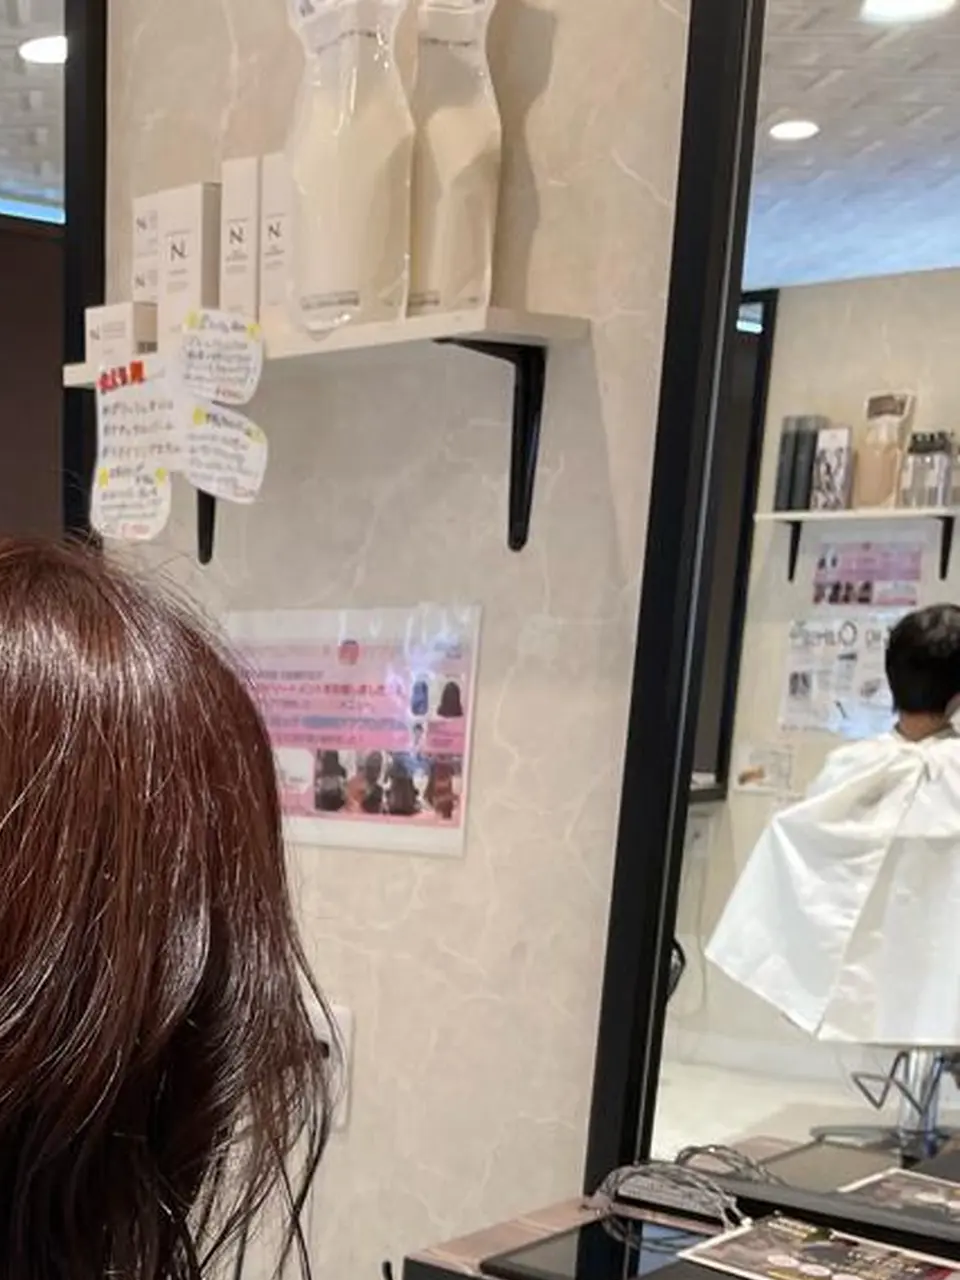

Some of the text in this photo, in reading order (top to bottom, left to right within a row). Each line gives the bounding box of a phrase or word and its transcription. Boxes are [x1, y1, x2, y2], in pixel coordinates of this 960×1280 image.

[229, 226, 244, 245] N
[268, 220, 282, 241] N
[170, 238, 188, 262] N
